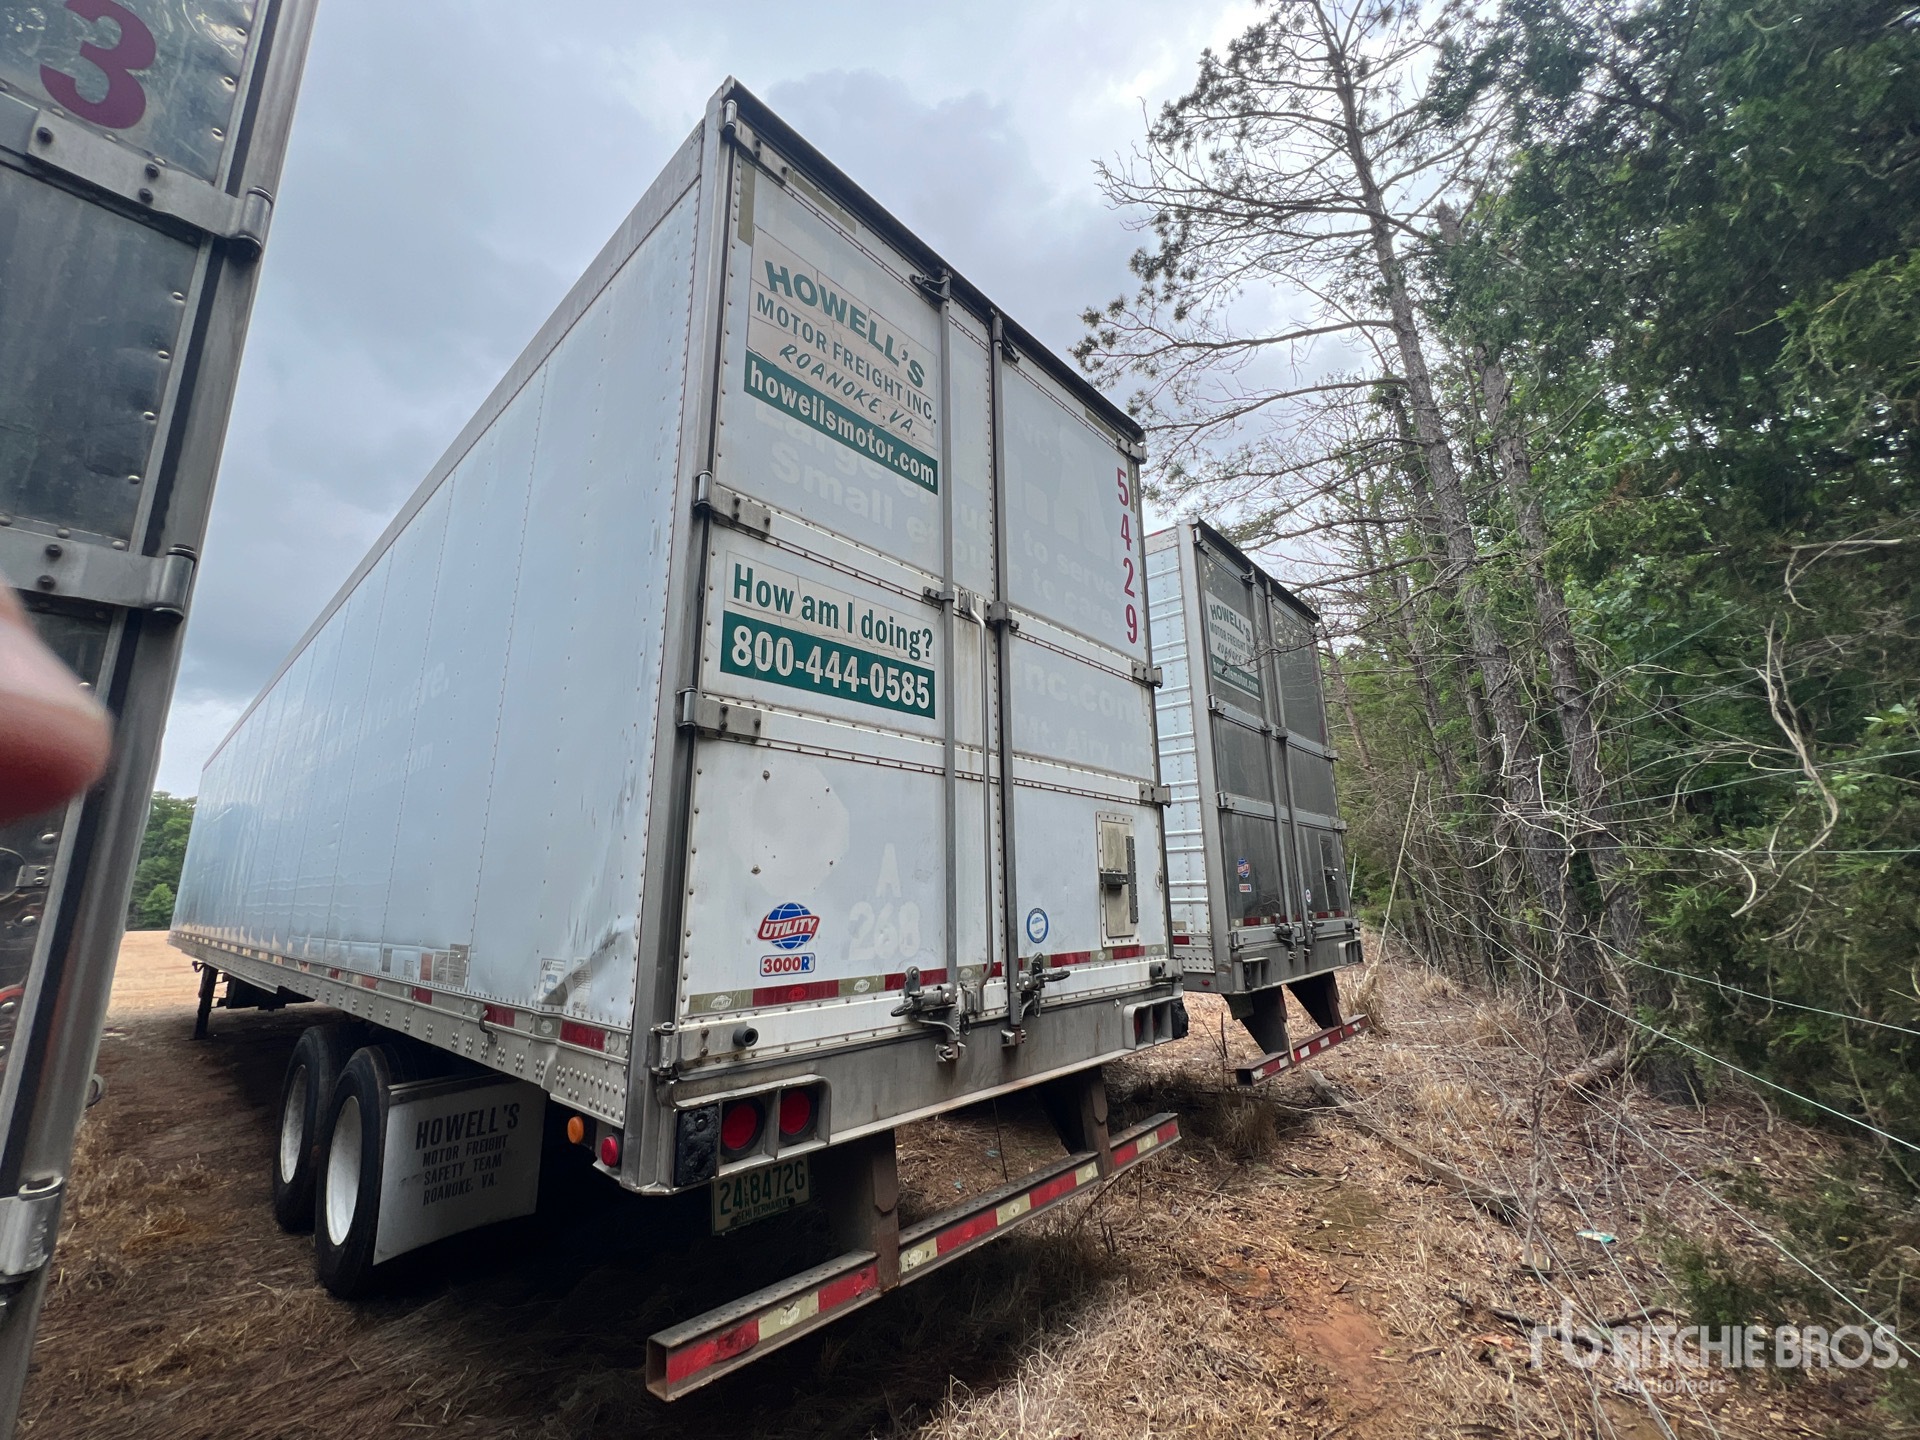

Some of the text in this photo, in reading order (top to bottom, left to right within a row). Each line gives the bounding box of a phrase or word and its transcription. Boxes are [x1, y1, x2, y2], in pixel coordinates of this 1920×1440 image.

[40, 0, 156, 129] 3
[764, 260, 925, 388] HOWELL'S
[757, 291, 937, 424] MOTOR FREIGHT INC.
[749, 360, 935, 487] howellsmotor.com
[889, 408, 917, 438] VA.
[733, 562, 933, 661] How am I doing?
[1209, 604, 1251, 641] HOWELL'S
[731, 624, 930, 709] 800-444-0585
[761, 918, 816, 938] UTILITY
[763, 955, 811, 974] 3000R
[416, 1103, 520, 1150] HOWELL'S
[422, 1134, 509, 1168] MOTOR FREIGHT
[423, 1153, 501, 1186] SAFETY TEAM
